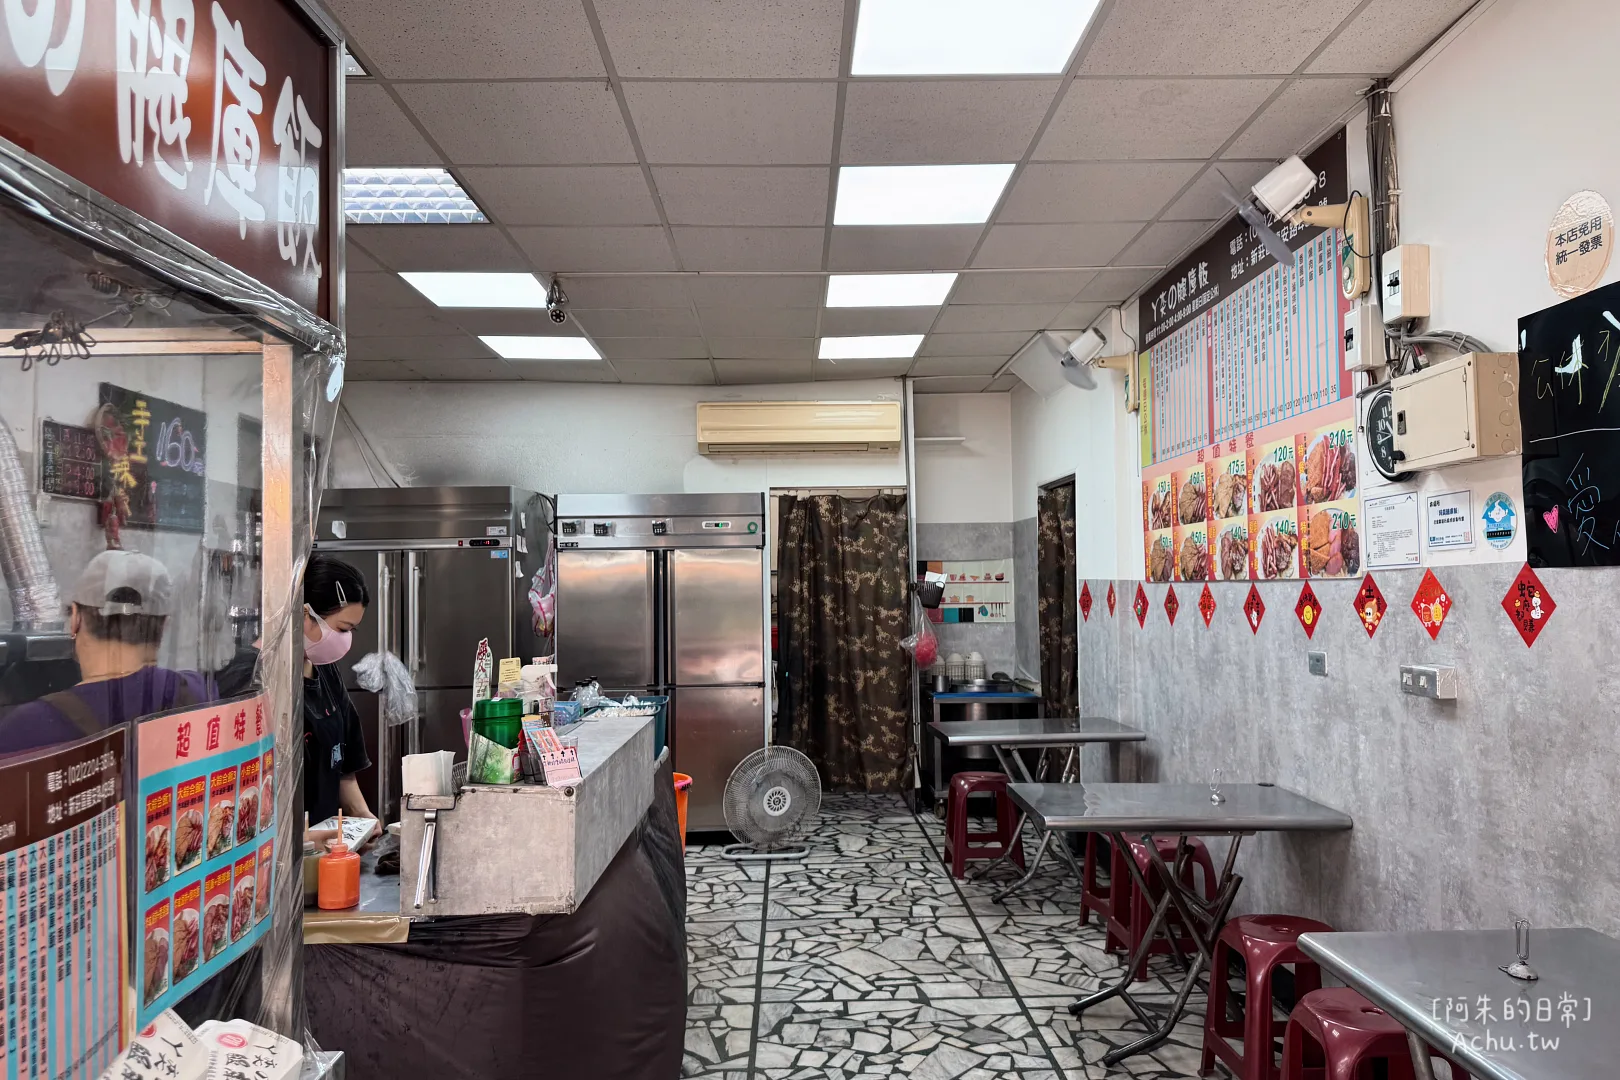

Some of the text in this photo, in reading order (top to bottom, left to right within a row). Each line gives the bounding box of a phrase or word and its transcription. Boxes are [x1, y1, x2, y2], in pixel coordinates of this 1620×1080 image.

[1555, 216, 1601, 247] 本店免用
[1556, 234, 1602, 266] 統一發票
[1310, 391, 1319, 401] 110
[1319, 387, 1328, 397] 110
[1330, 384, 1337, 394] 35
[1293, 398, 1301, 408] 120
[1301, 394, 1310, 404] 110
[1378, 419, 1385, 430] 10
[1329, 429, 1353, 449] 210元
[1273, 445, 1294, 462] 120元
[1381, 446, 1386, 458] 8
[1229, 460, 1245, 474] 175元
[1190, 472, 1205, 484] 160元
[1275, 520, 1296, 534] 140元
[1332, 512, 1356, 530] 210元
[1191, 532, 1206, 544] 150元
[1230, 526, 1247, 539] 140元
[176, 702, 263, 759] 超值特餐
[211, 770, 237, 788] 大綜合飯3
[177, 781, 206, 800] 大綜合飯2
[147, 793, 172, 813] 大綜合飯1
